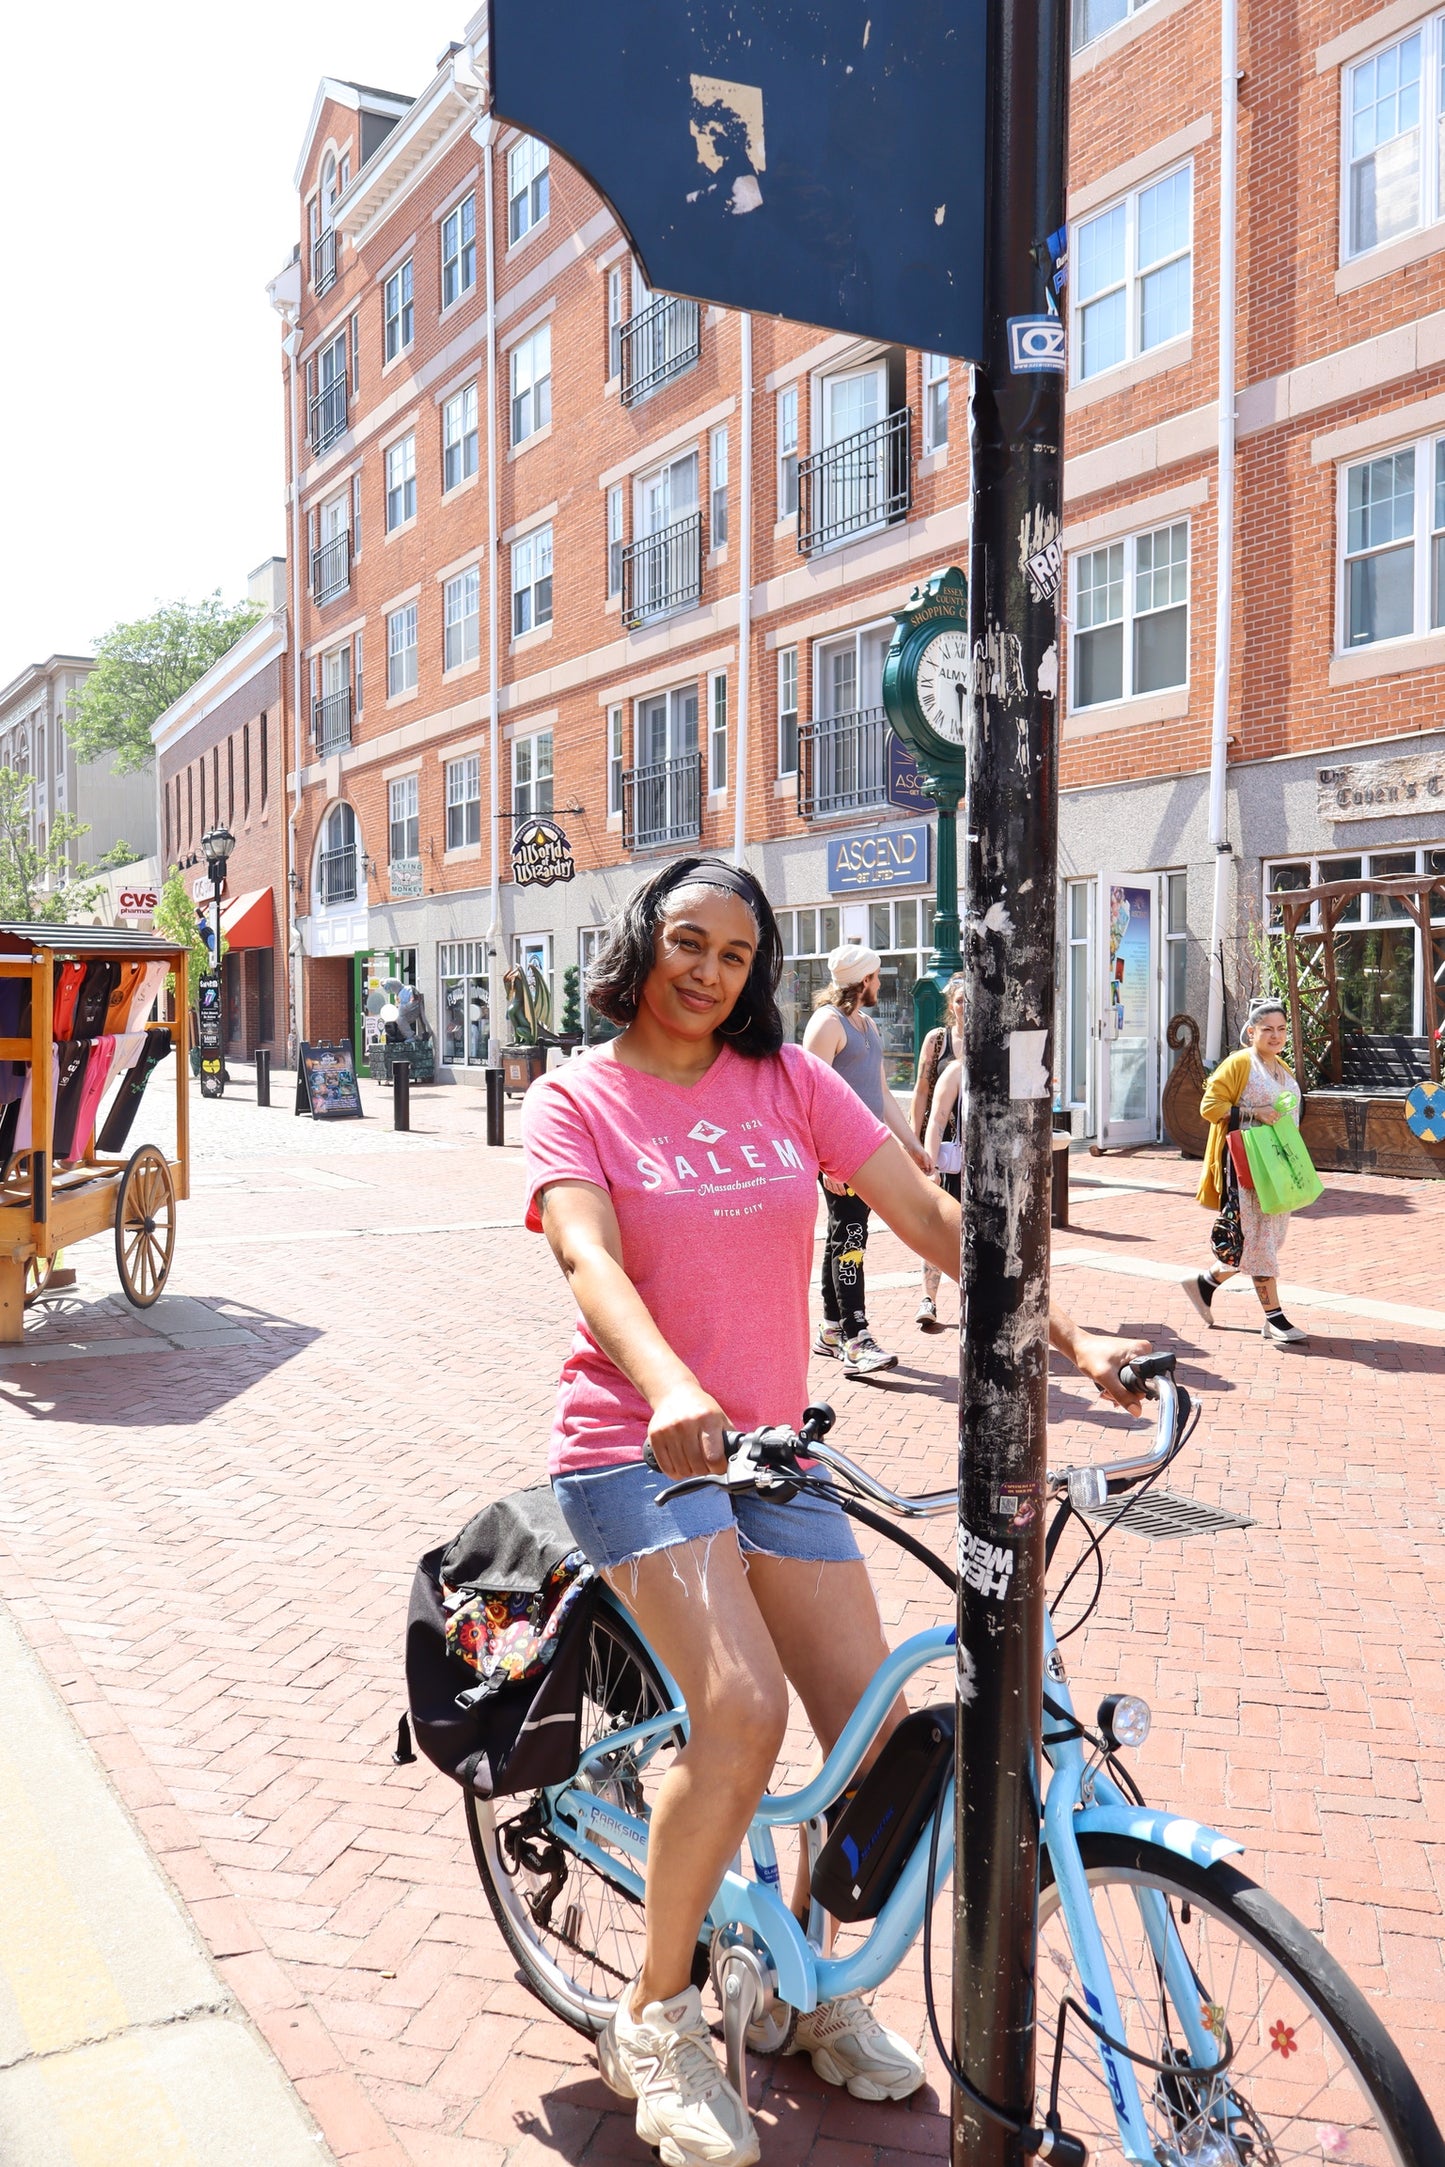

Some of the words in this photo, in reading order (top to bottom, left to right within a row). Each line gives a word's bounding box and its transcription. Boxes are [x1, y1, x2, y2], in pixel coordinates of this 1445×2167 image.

[943, 586, 963, 597] ESSEX
[910, 605, 956, 628] SHOPPING
[1320, 769, 1347, 784] The
[1336, 779, 1417, 810] Coven's
[520, 840, 563, 865] World
[541, 856, 551, 866] of
[836, 833, 918, 871] ASCEND
[515, 859, 572, 882] Wizardry
[120, 893, 158, 908] CVS
[120, 907, 154, 915] pharmac
[636, 1138, 805, 1190] SALEM
[697, 1176, 767, 1197] Massachusetts
[714, 1208, 741, 1217] WITCH
[744, 1203, 764, 1215] CITY
[591, 1806, 647, 1846] PARKSIDE
